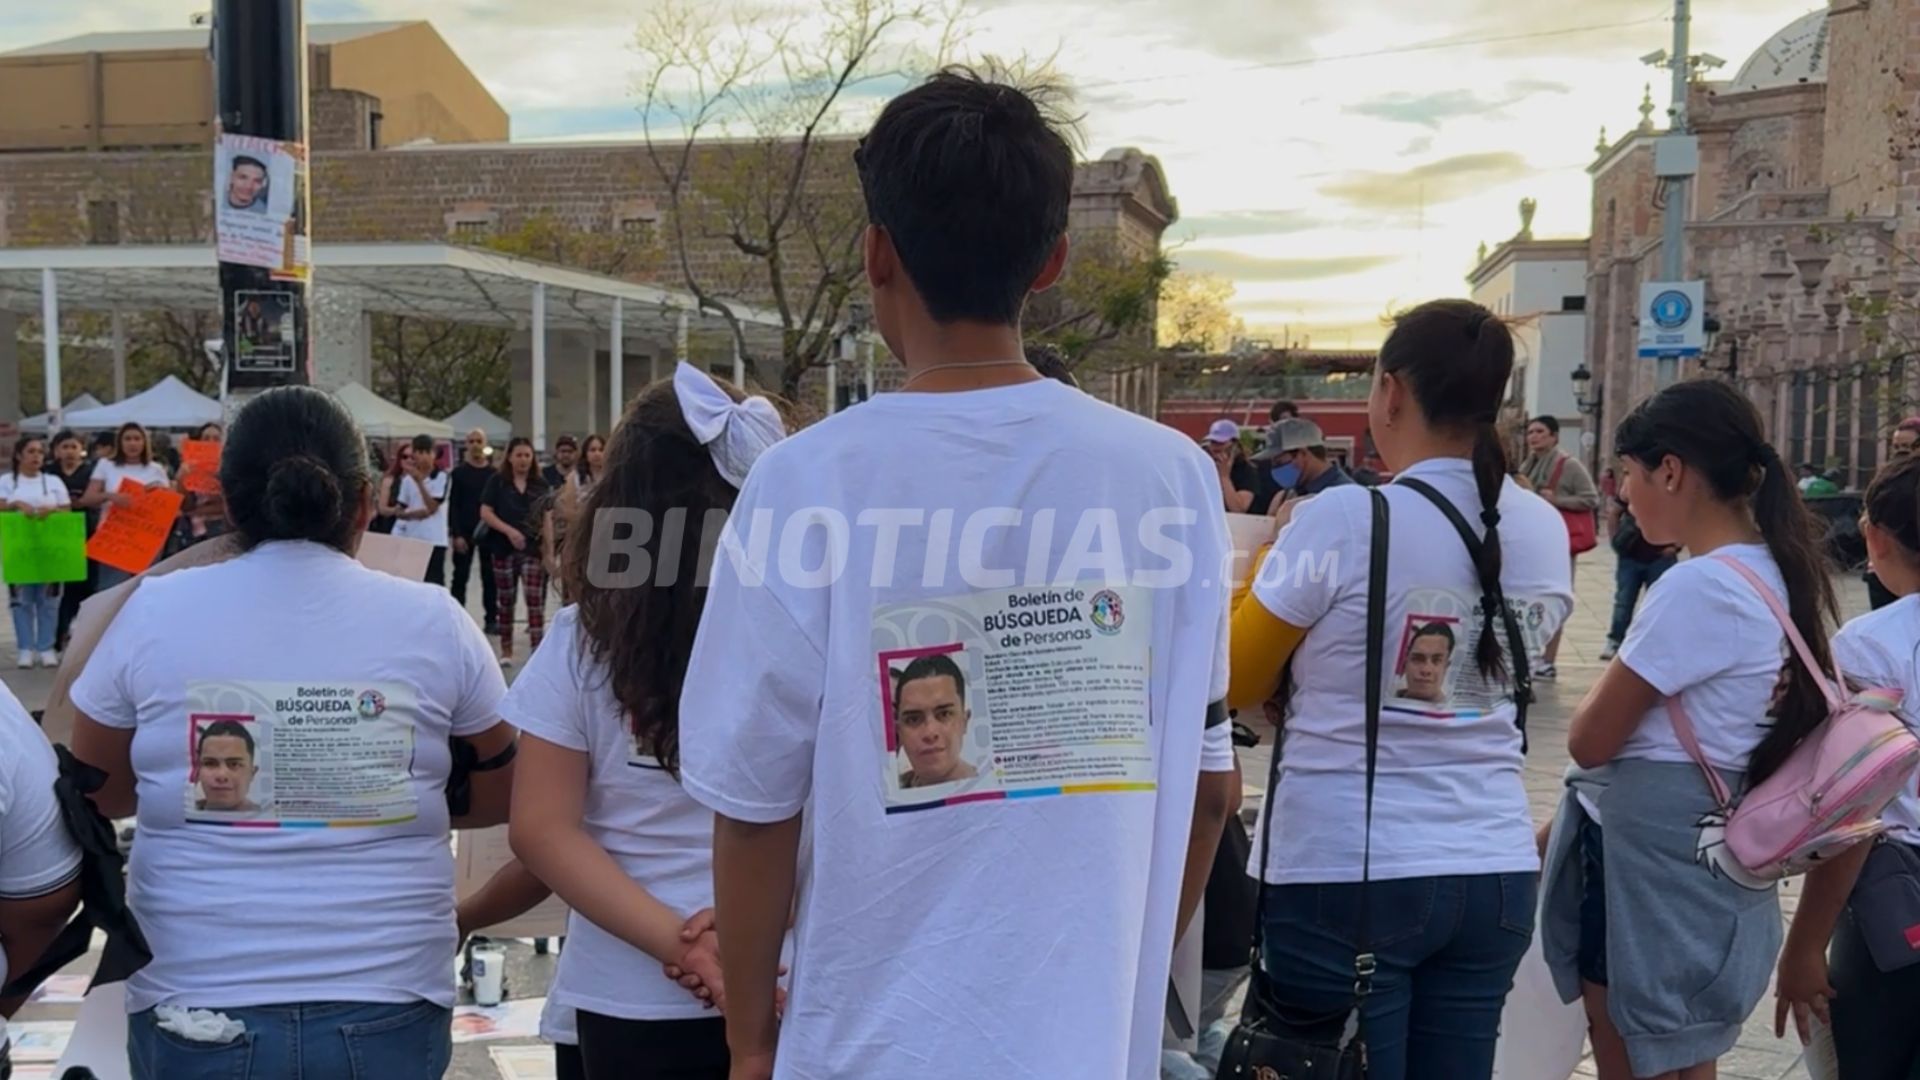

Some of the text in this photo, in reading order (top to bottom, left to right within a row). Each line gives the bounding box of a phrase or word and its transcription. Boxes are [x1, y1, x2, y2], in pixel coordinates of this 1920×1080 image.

[1008, 588, 1085, 608] Boletín de
[984, 607, 1082, 631] BÚSQUEDA
[1001, 628, 1092, 648] de Personas
[297, 687, 355, 698] Boletín de
[275, 697, 352, 712] BÚSQUEDA
[288, 715, 358, 725] de Personas
